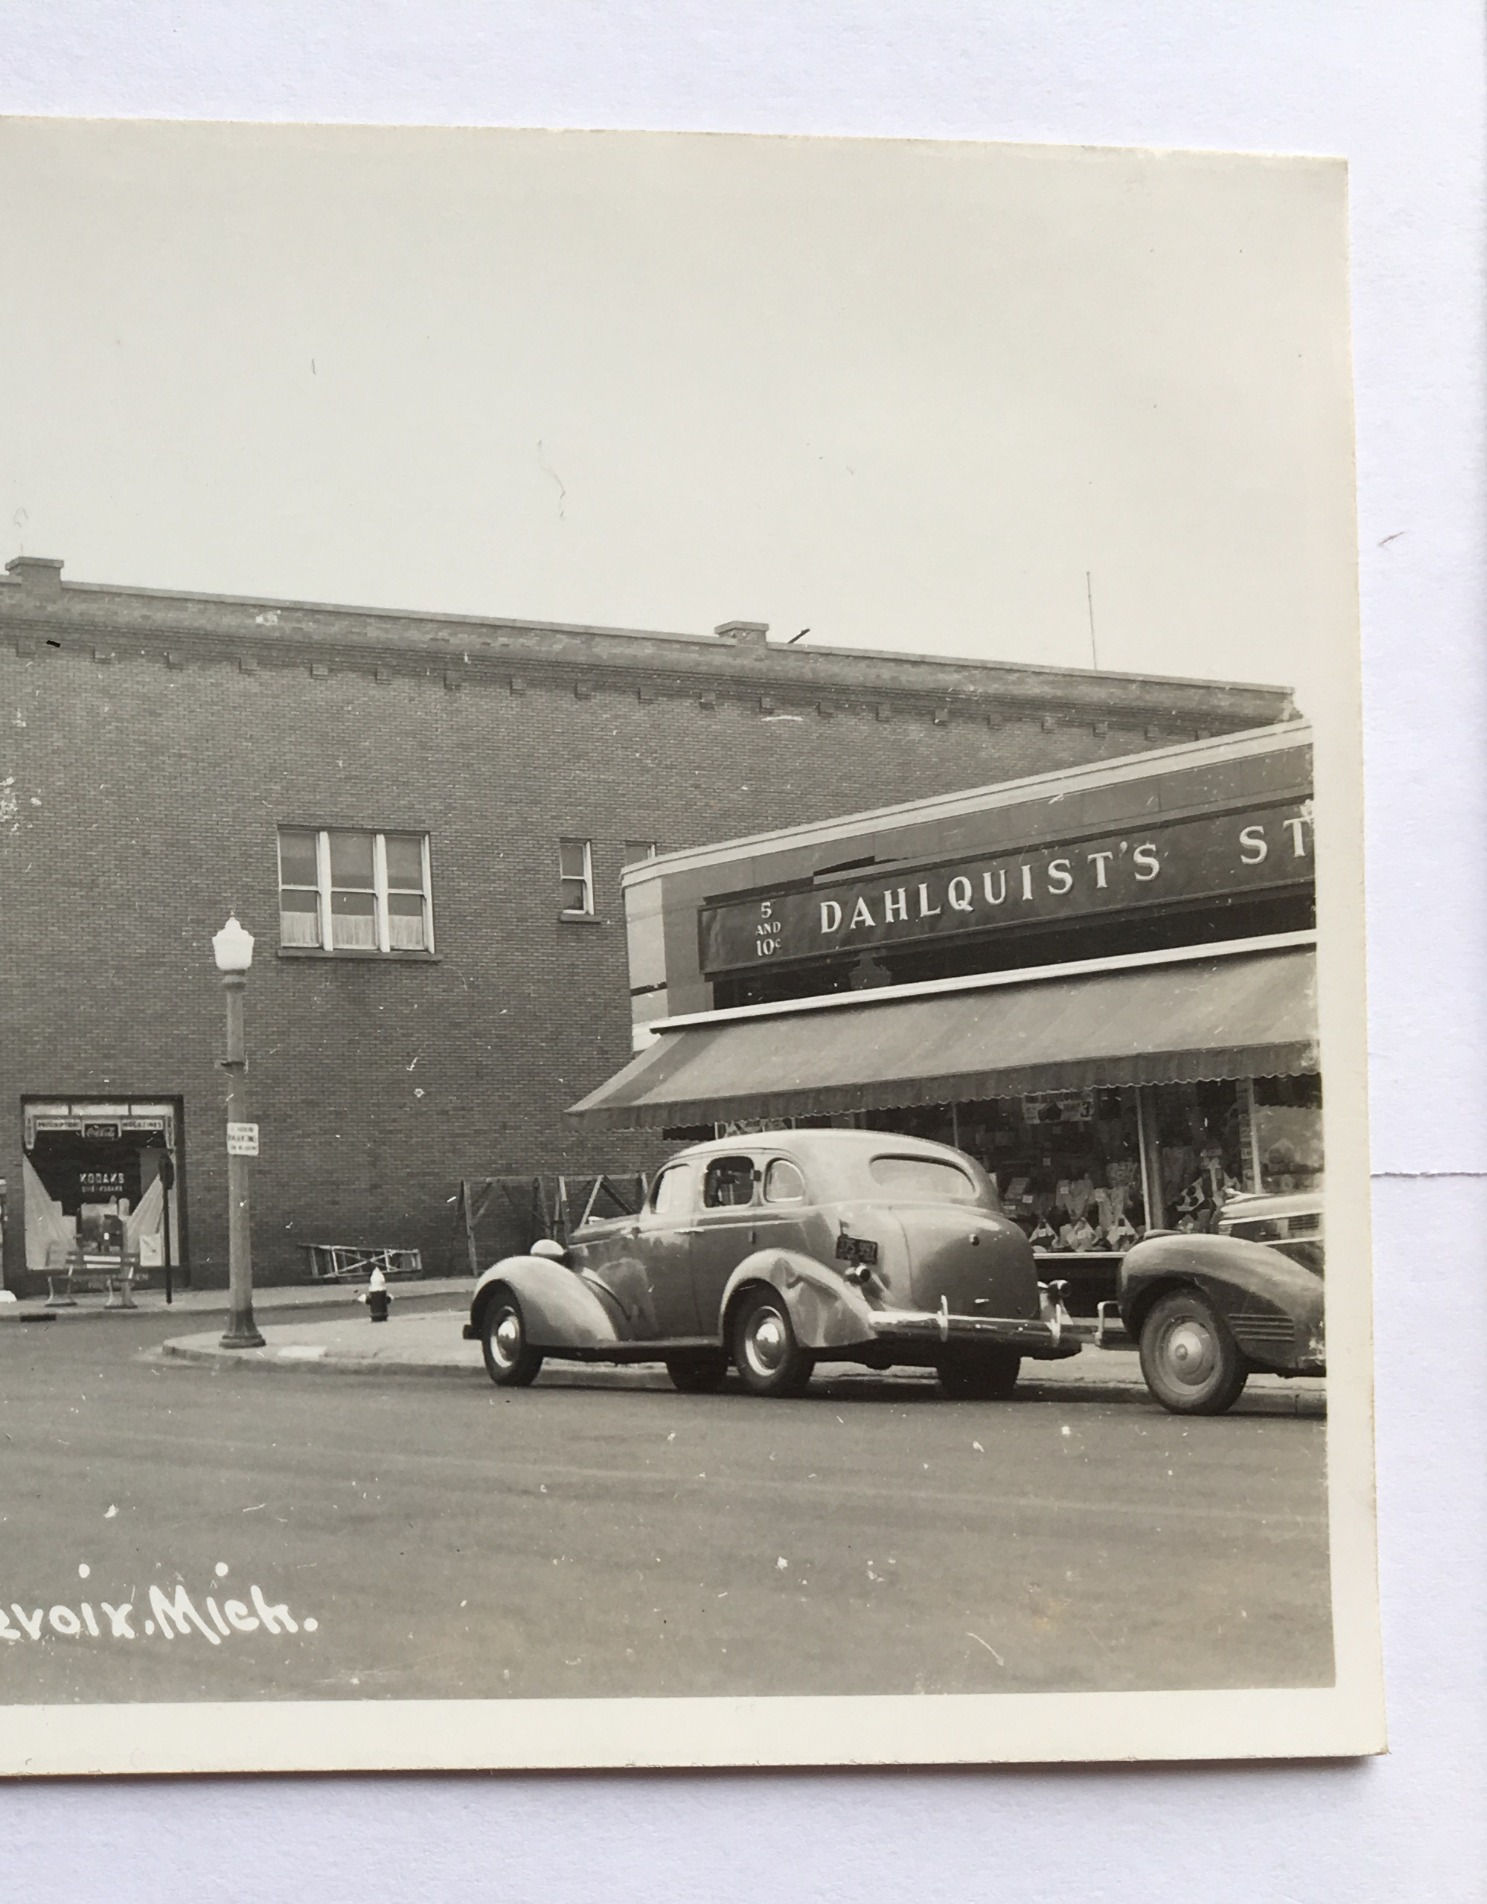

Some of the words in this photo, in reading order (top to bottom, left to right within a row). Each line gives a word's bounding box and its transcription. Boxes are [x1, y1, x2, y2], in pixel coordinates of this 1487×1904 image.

[820, 841, 1161, 934] DAHLQUIST'S
[761, 901, 772, 918] 5
[755, 921, 781, 935] AND
[80, 1173, 125, 1184] KODAKS
